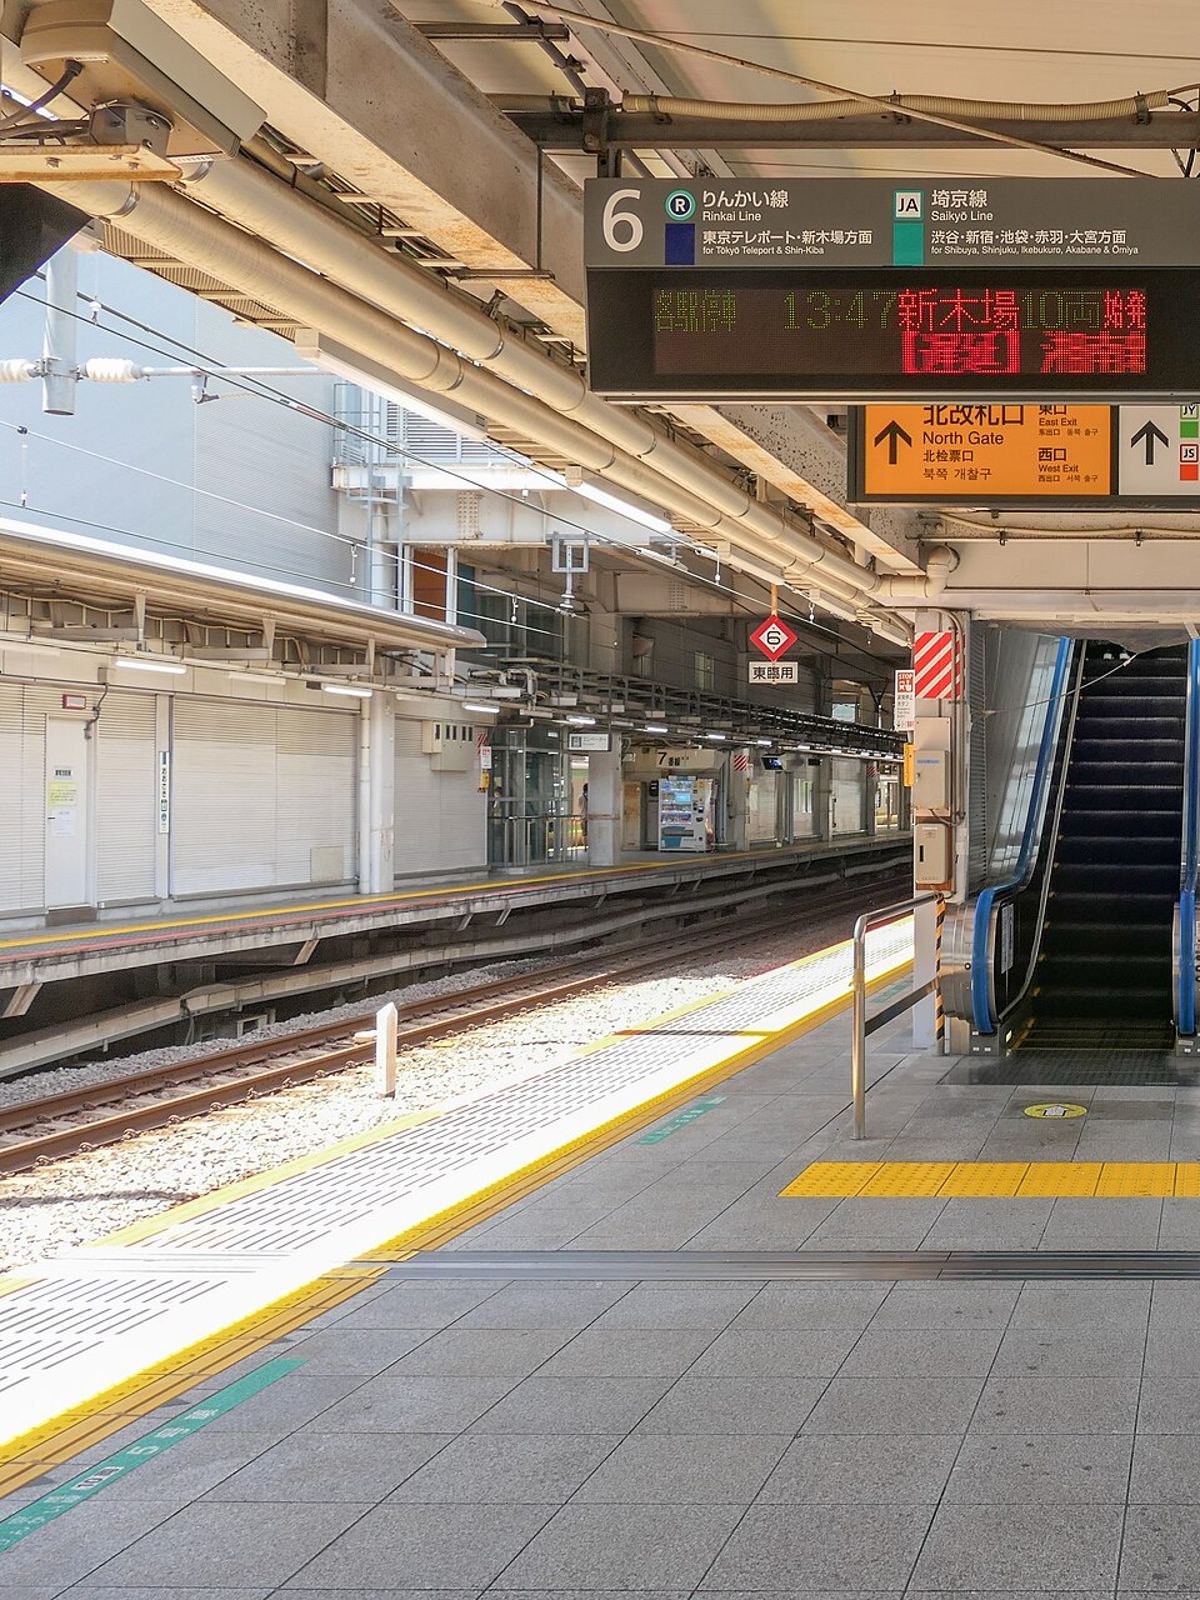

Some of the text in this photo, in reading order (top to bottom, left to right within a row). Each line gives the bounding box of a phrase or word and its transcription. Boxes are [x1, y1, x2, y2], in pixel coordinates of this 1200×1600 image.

[674, 198, 686, 212] R
[702, 189, 789, 209] りんかい線
[898, 198, 919, 213] JA
[931, 189, 988, 208] 埼京線
[602, 189, 644, 252] 6
[702, 211, 762, 222] Rinkai Line
[931, 211, 993, 223] Saikyō Line
[702, 230, 873, 245] 東京テレポート・新木場方面
[931, 230, 1127, 245] 渋谷・新宿・池袋・赤羽・大宮方面
[702, 246, 714, 254] for
[742, 246, 775, 256] Teleport
[776, 246, 783, 254] &
[785, 246, 824, 255] Shin-Kiba
[931, 246, 942, 254] for
[944, 246, 980, 255] Shibuya,
[982, 246, 1019, 256] Shinjuku,
[1020, 246, 1063, 255] Ikebukuro,
[1065, 246, 1102, 254] Akabane
[1103, 246, 1110, 254] &
[784, 291, 898, 329] 13:47
[898, 288, 1020, 331] 新木場
[1022, 291, 1102, 328] 10両
[923, 404, 1025, 426] 北改札口
[1038, 404, 1067, 416] 東口
[1183, 405, 1196, 415] JY
[1038, 417, 1078, 426] East Exit
[923, 431, 1004, 445] North Gate
[1038, 447, 1067, 461] 西口
[1183, 448, 1195, 458] JS
[923, 467, 993, 481] 북쪽 개찰구
[1038, 464, 1079, 473] West Exit
[766, 630, 781, 646] 6
[753, 666, 794, 680] 東臨用
[898, 672, 914, 680] STOP
[657, 751, 668, 765] 7
